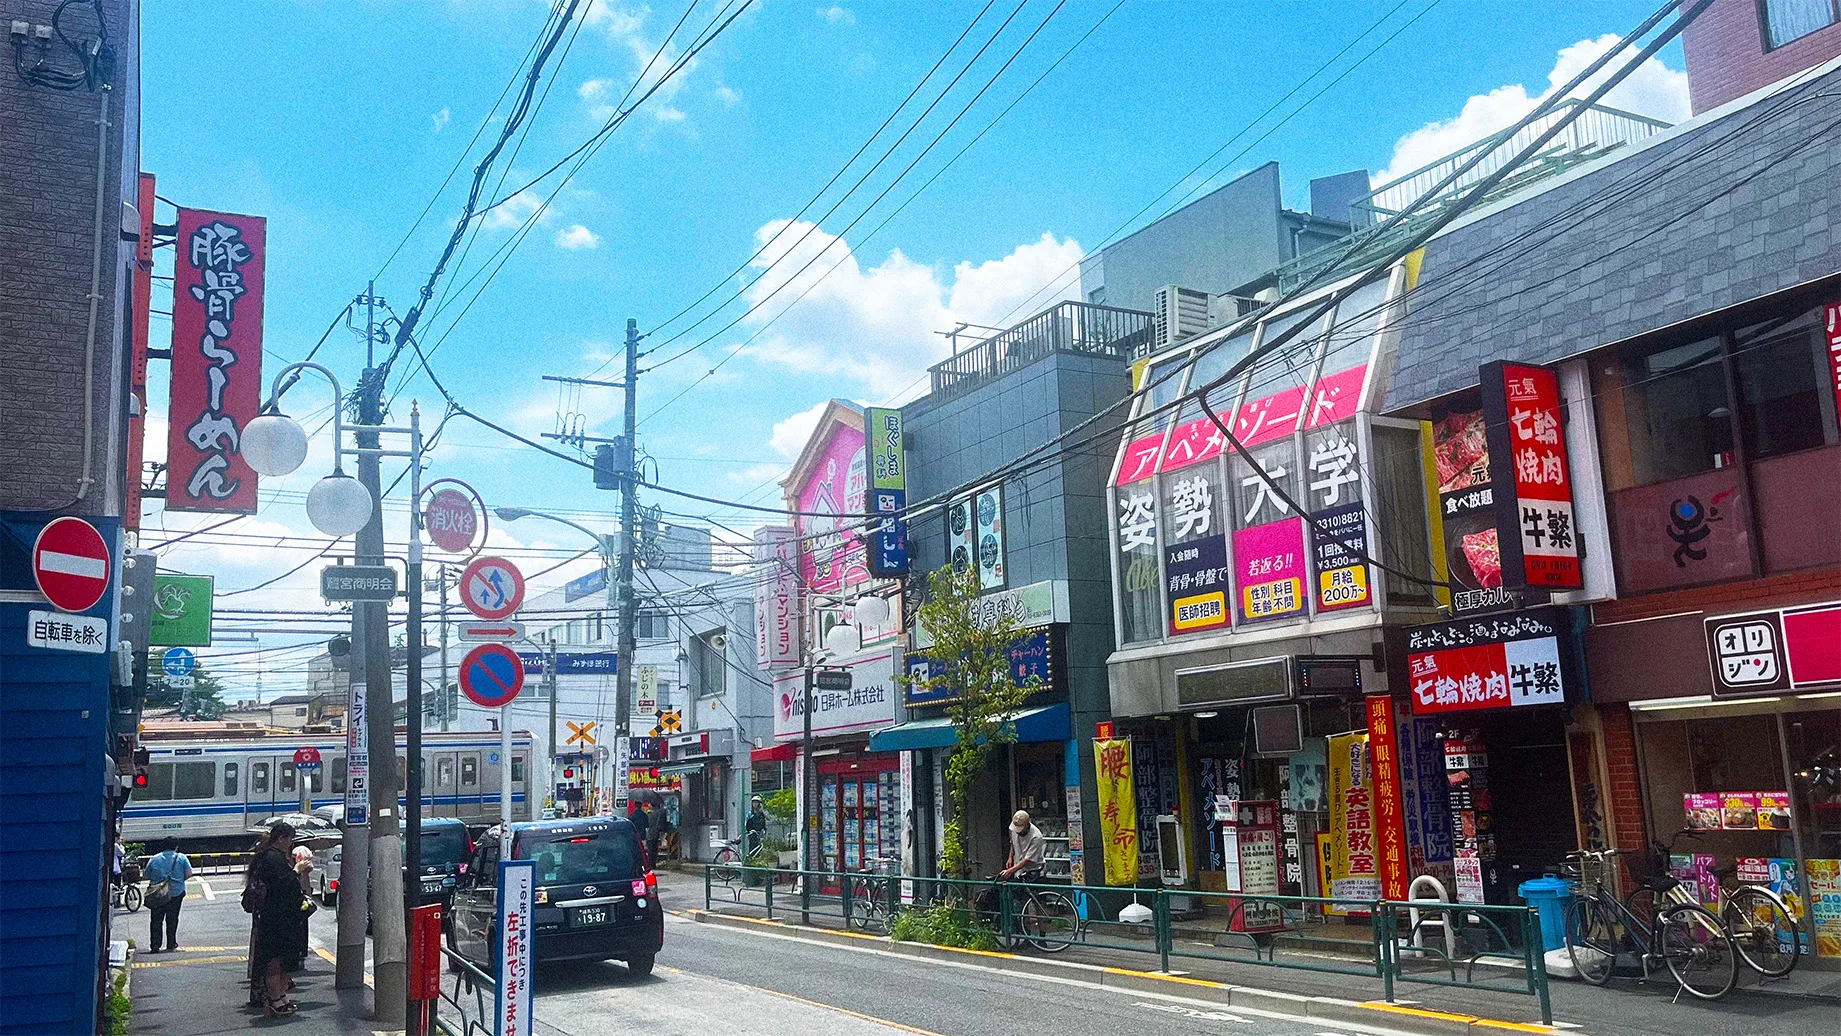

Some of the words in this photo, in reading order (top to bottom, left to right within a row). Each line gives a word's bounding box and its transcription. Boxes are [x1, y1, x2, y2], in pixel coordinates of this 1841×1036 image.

[187, 222, 252, 498] 豚骨らーめん
[1129, 387, 1340, 480] アベメソード
[1511, 407, 1558, 445] 七輪
[1516, 447, 1564, 485] 焼肉
[1119, 437, 1359, 552] 姿勢大学
[1445, 489, 1494, 514] 食べ放題
[431, 507, 473, 535] 消火栓
[1522, 507, 1572, 549] 牛繁
[1170, 548, 1200, 564] 入会随時
[1317, 555, 1349, 569] ¥3,500
[1251, 586, 1270, 601] 性別
[1273, 582, 1293, 596] 科目
[1331, 571, 1353, 586] 月給
[1178, 601, 1221, 621] 医師招聘
[34, 620, 104, 646] 自転車を除く
[1724, 629, 1764, 650] オリ
[572, 659, 610, 668] みずほ銀行
[1728, 658, 1769, 679] ジン
[1414, 671, 1508, 706] 七輪焼肉
[1510, 662, 1560, 697] 牛繁
[821, 684, 885, 712] 日昇ホーム株式会社
[1448, 729, 1460, 739] 2F
[1371, 699, 1402, 899] 頭痛・眼精疲労・交通事故
[1345, 786, 1376, 875] 英語教室
[519, 878, 528, 991] この先工事中につき
[506, 911, 519, 1036] 左折できませ
